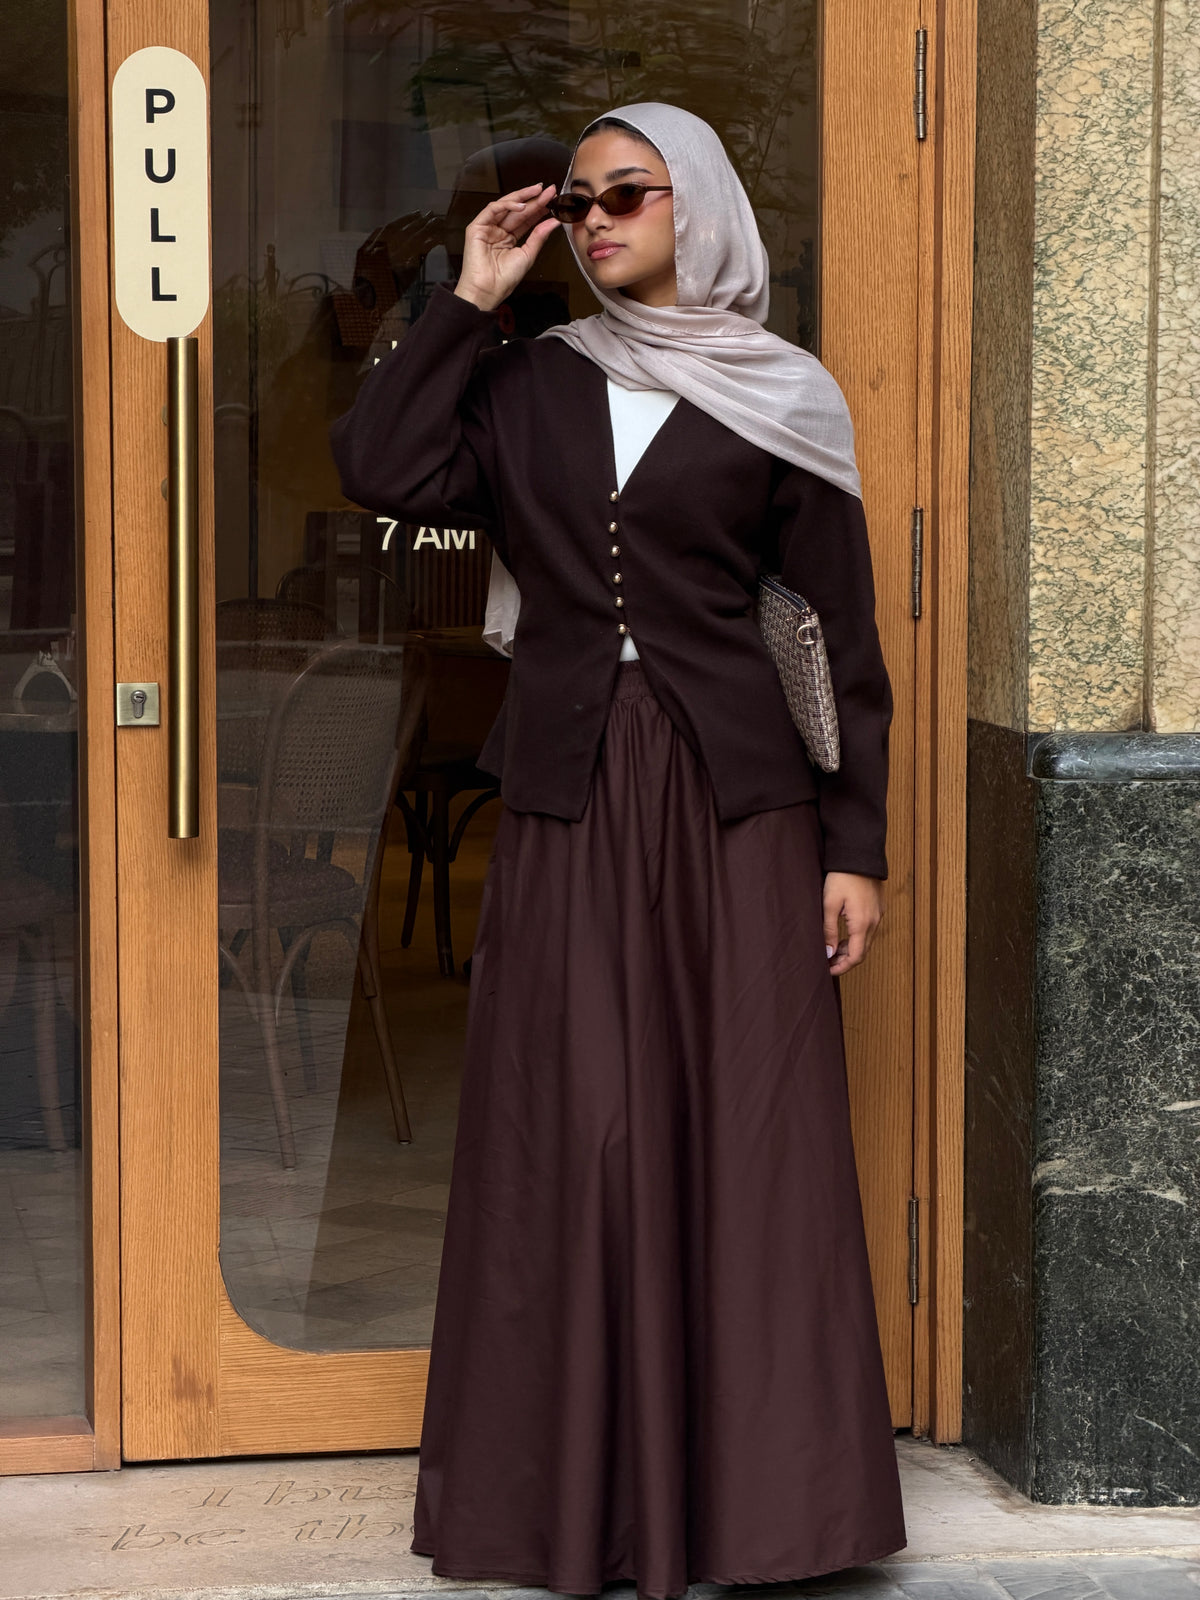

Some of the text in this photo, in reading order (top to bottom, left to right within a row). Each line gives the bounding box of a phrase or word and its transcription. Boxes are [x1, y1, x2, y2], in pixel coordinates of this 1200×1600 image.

[144, 88, 177, 301] PULL
[376, 517, 475, 550] 7 AM
[290, 1513, 416, 1542] th
